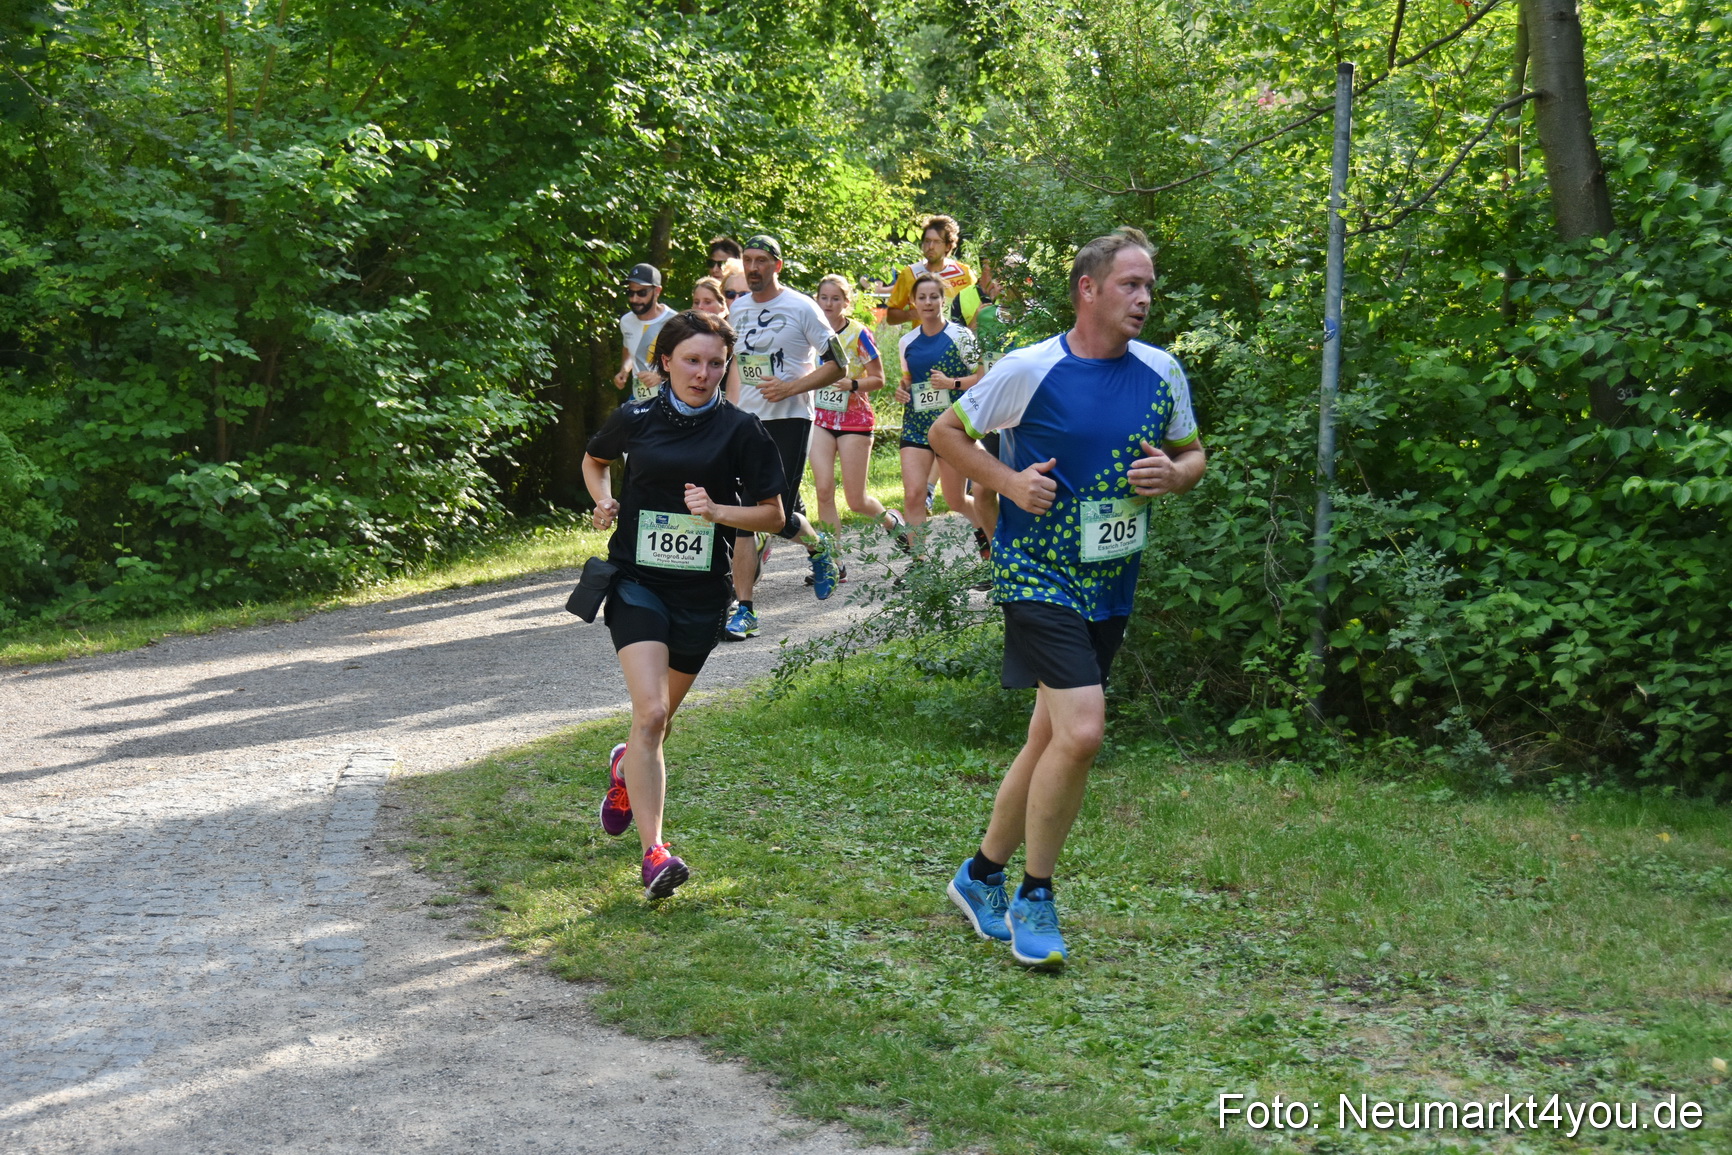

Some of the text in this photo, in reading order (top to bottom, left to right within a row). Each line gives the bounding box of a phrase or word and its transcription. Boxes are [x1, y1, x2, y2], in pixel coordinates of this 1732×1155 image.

[743, 366, 762, 378] 680
[637, 387, 652, 398] 621
[818, 390, 843, 403] 1324
[919, 390, 940, 403] 267
[1098, 517, 1137, 544] 205
[647, 531, 703, 555] 1864
